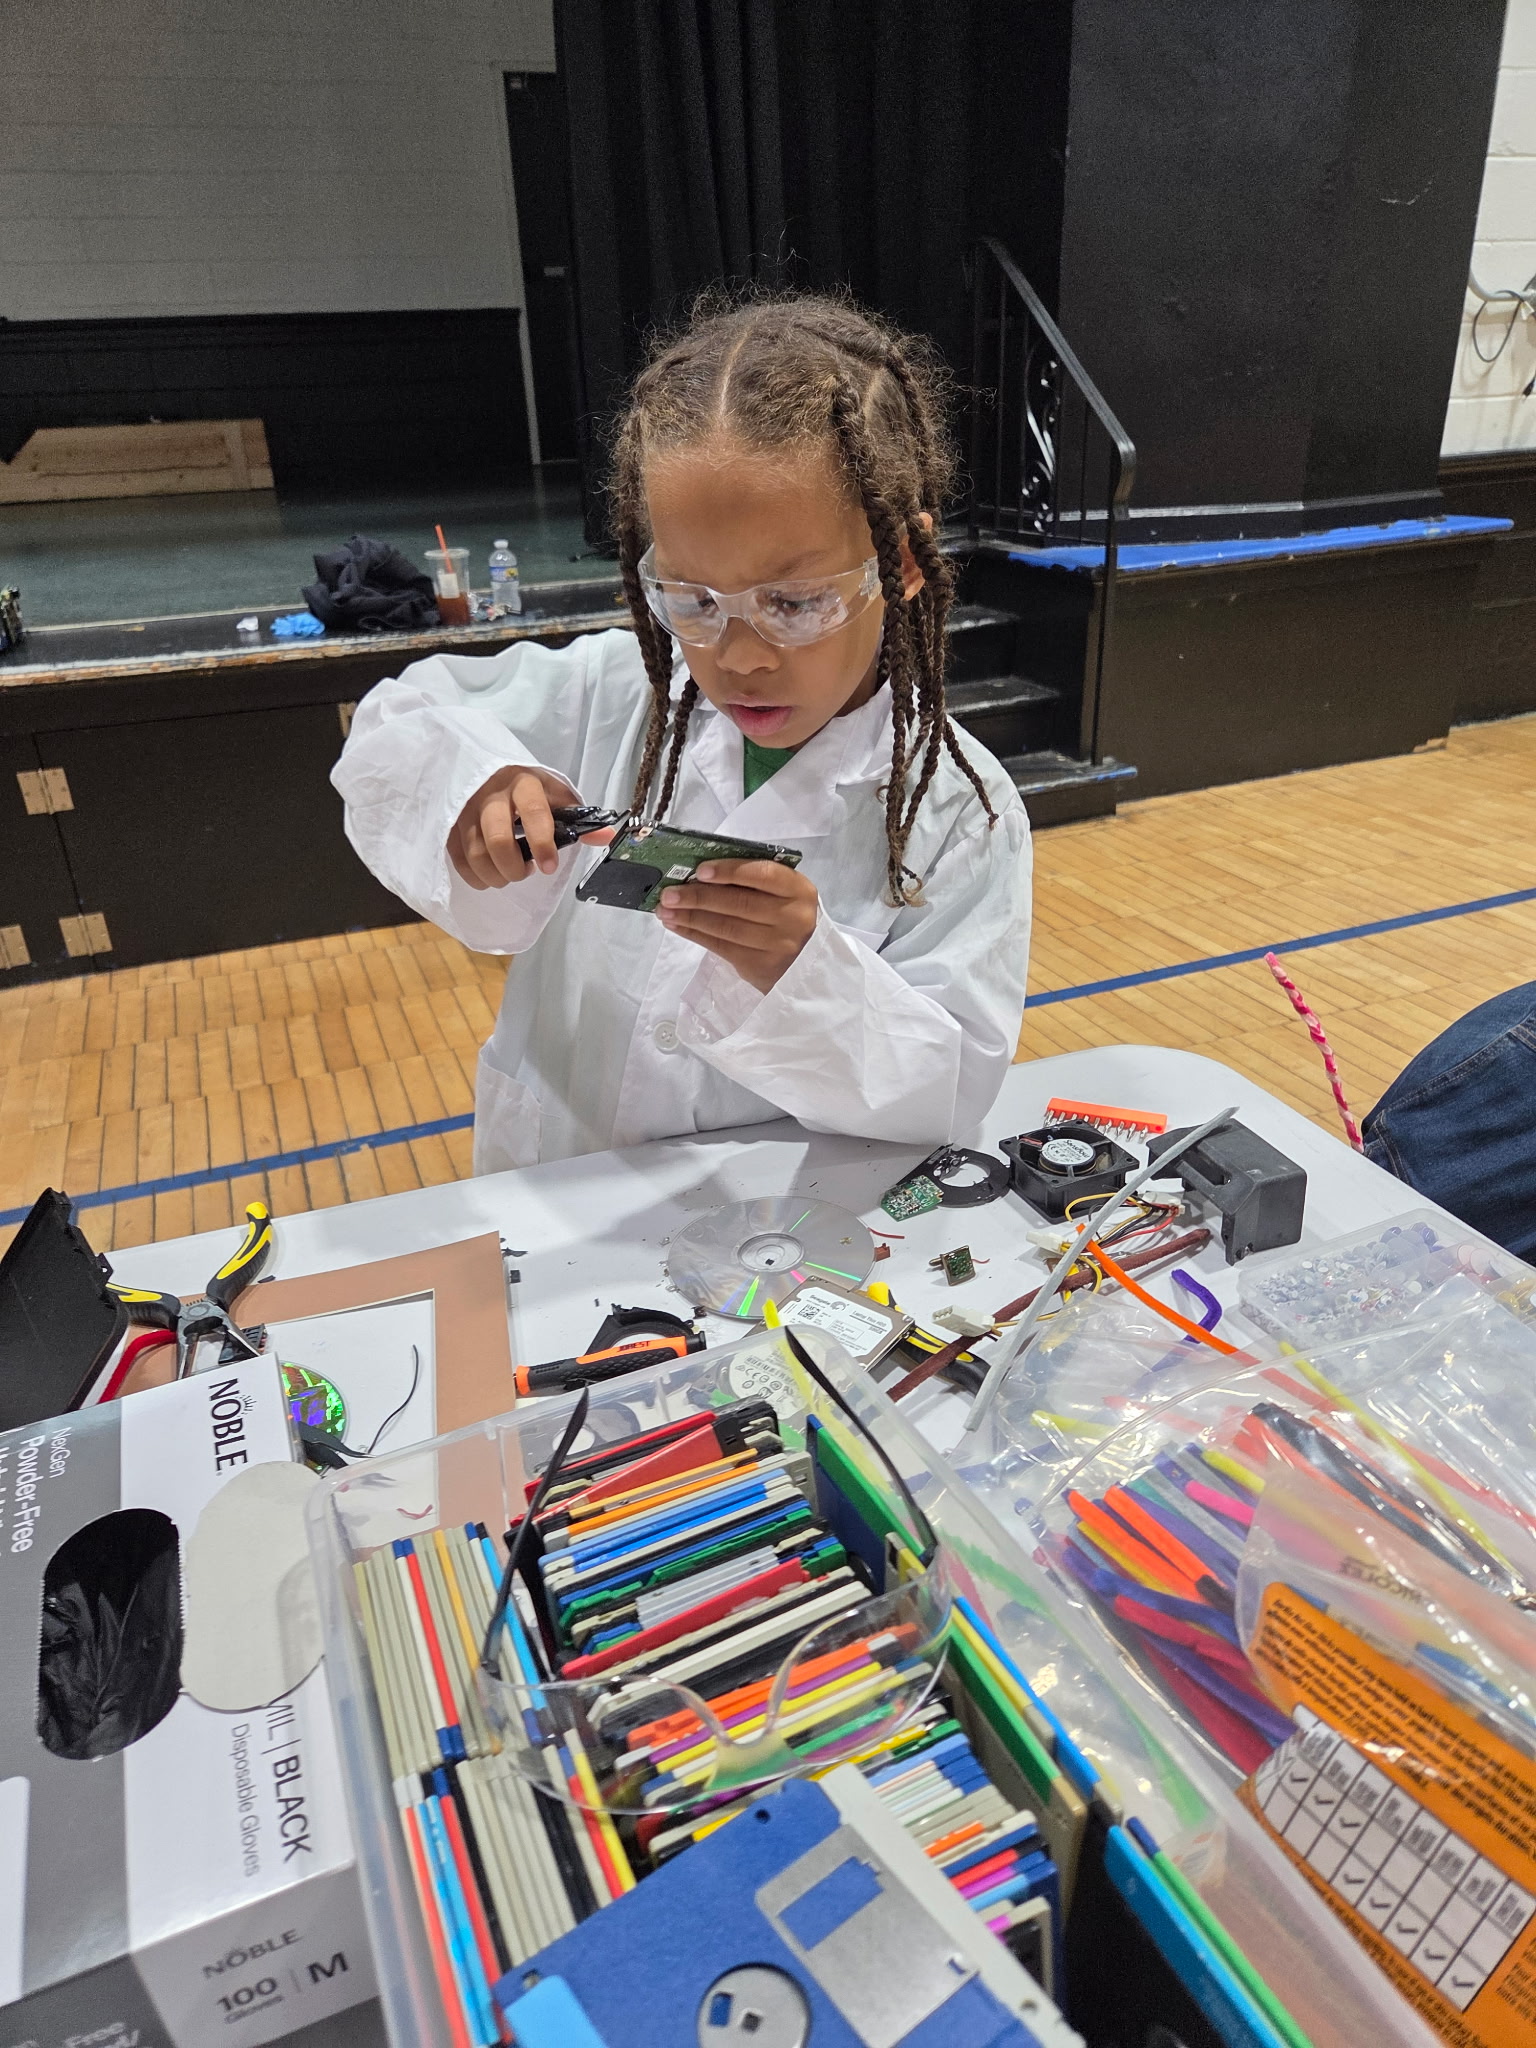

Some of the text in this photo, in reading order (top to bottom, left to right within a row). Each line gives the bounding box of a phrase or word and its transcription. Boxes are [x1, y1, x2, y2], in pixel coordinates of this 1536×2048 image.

[49, 1426, 73, 1479] NexGen
[208, 1377, 249, 1472] NOBLE
[11, 1434, 46, 1553] Powder-Free
[228, 1723, 262, 1878] Disposable Gloves
[273, 1754, 313, 1864] BLACK
[203, 1928, 303, 1979] NOBLE
[217, 1951, 349, 2011] 100 M
